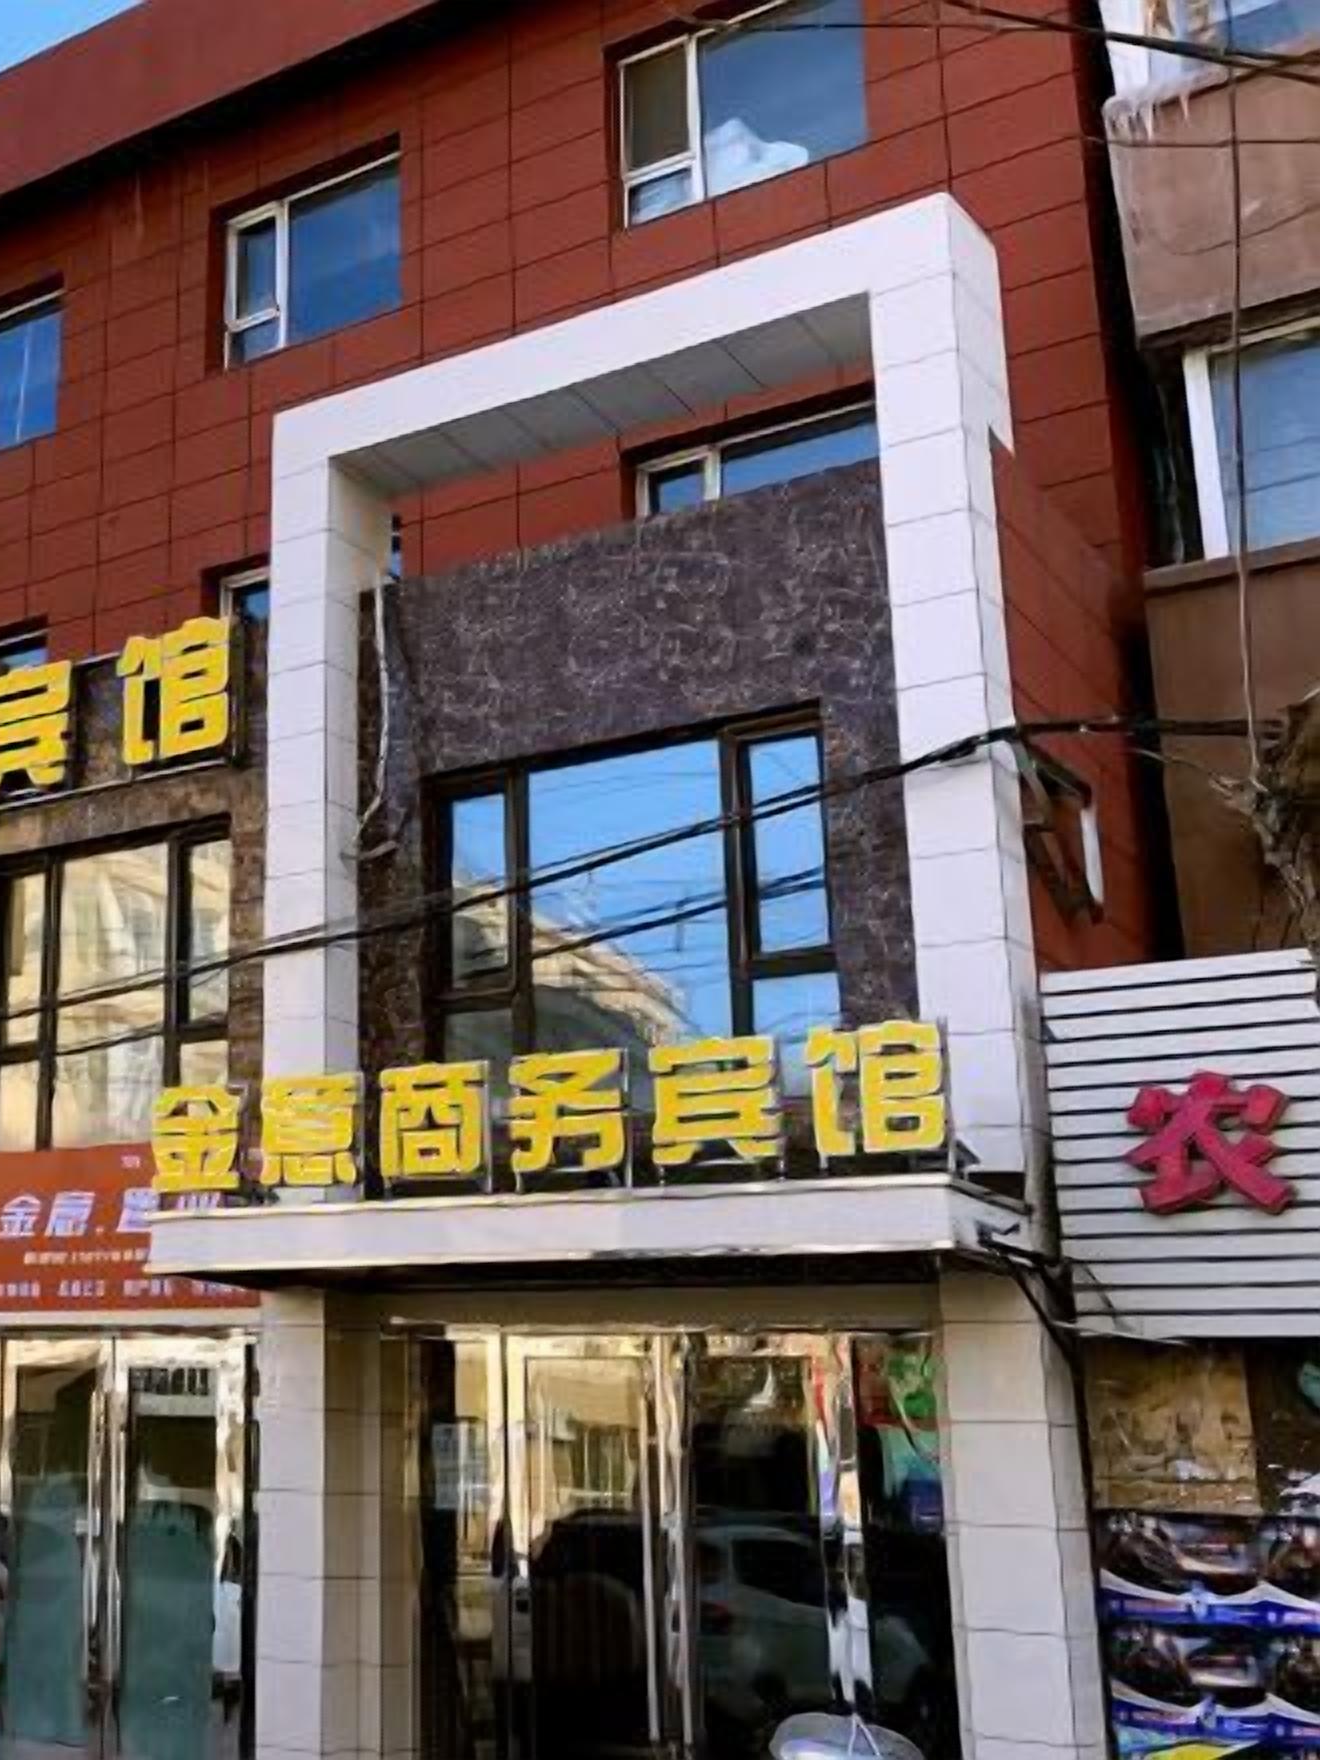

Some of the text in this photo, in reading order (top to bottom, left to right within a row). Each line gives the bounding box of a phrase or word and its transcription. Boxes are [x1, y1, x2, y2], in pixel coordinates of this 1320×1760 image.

[150, 1019, 947, 1194] 金意商务宾馆
[1124, 1069, 1299, 1215] 农
